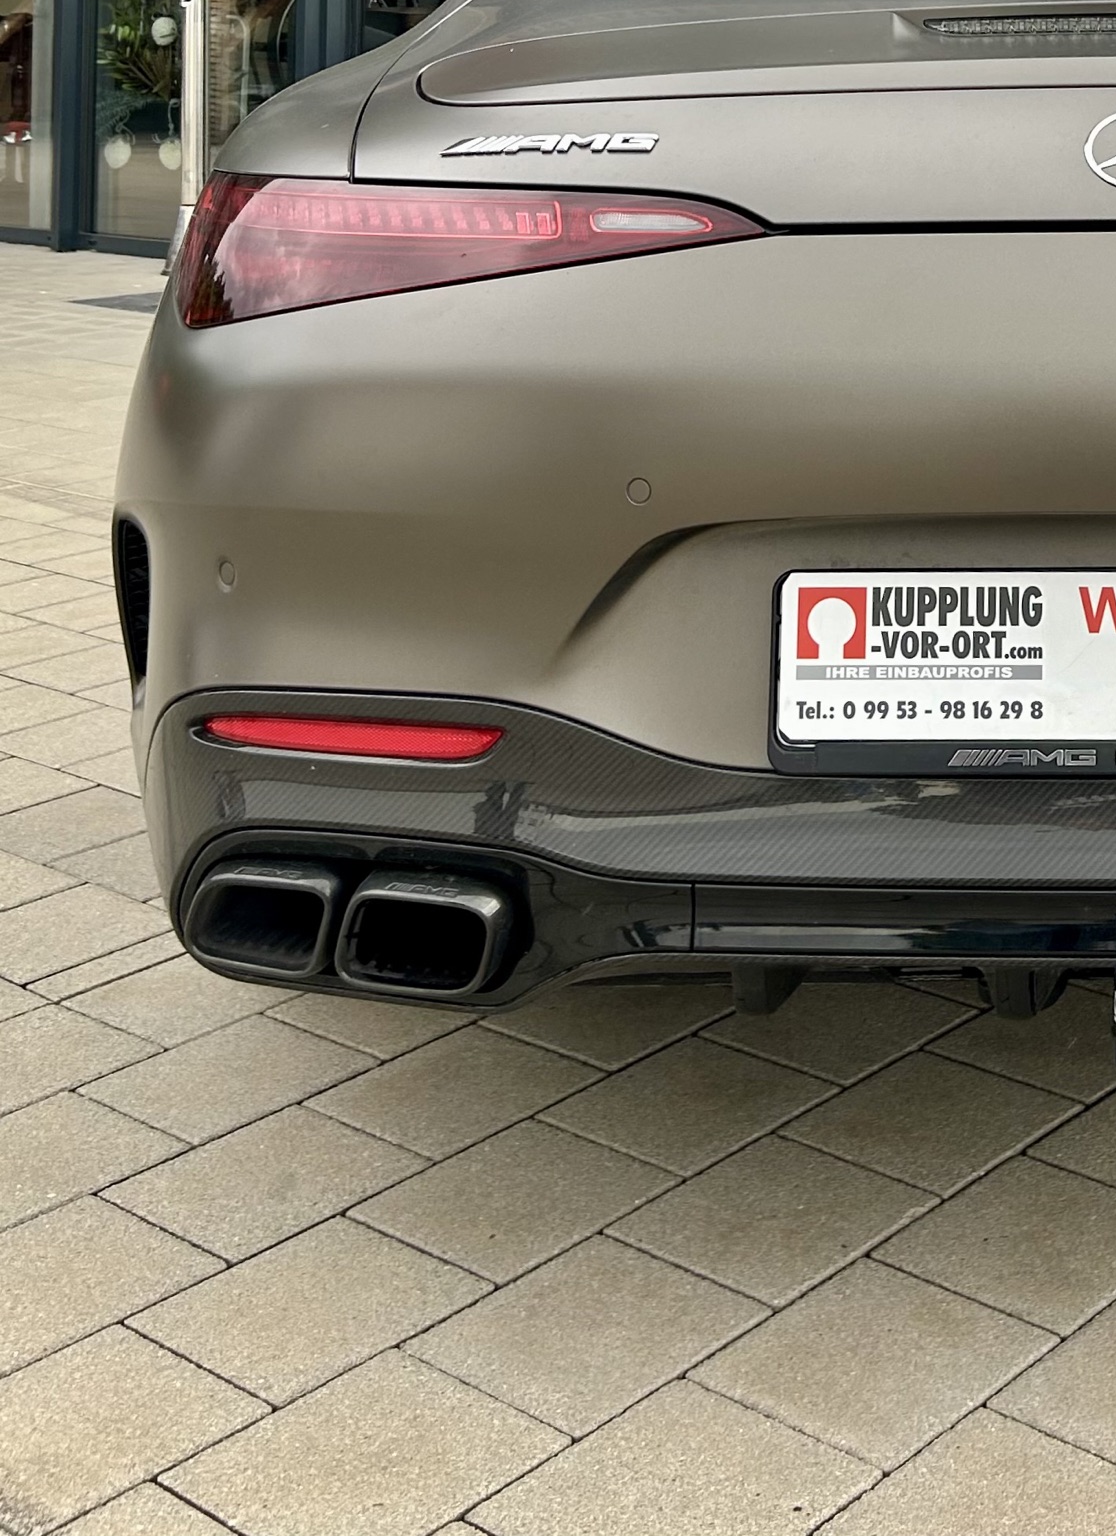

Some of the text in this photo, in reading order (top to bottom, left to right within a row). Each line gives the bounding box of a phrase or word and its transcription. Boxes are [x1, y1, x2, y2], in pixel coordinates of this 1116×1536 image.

[504, 133, 660, 155] AMG
[871, 585, 1043, 627] KUPPLUNG
[871, 630, 1043, 659] -VOR-ORT.com
[825, 666, 1013, 679] IHRE EINBAUPROFIS
[796, 701, 835, 720] Tel.:
[843, 701, 856, 720] 0
[863, 701, 890, 720] 99
[896, 701, 918, 720] 53
[940, 701, 966, 720] 98
[972, 701, 993, 720] 16
[1000, 701, 1024, 720] 29
[1030, 701, 1044, 720] 8
[998, 749, 1097, 766] AMG
